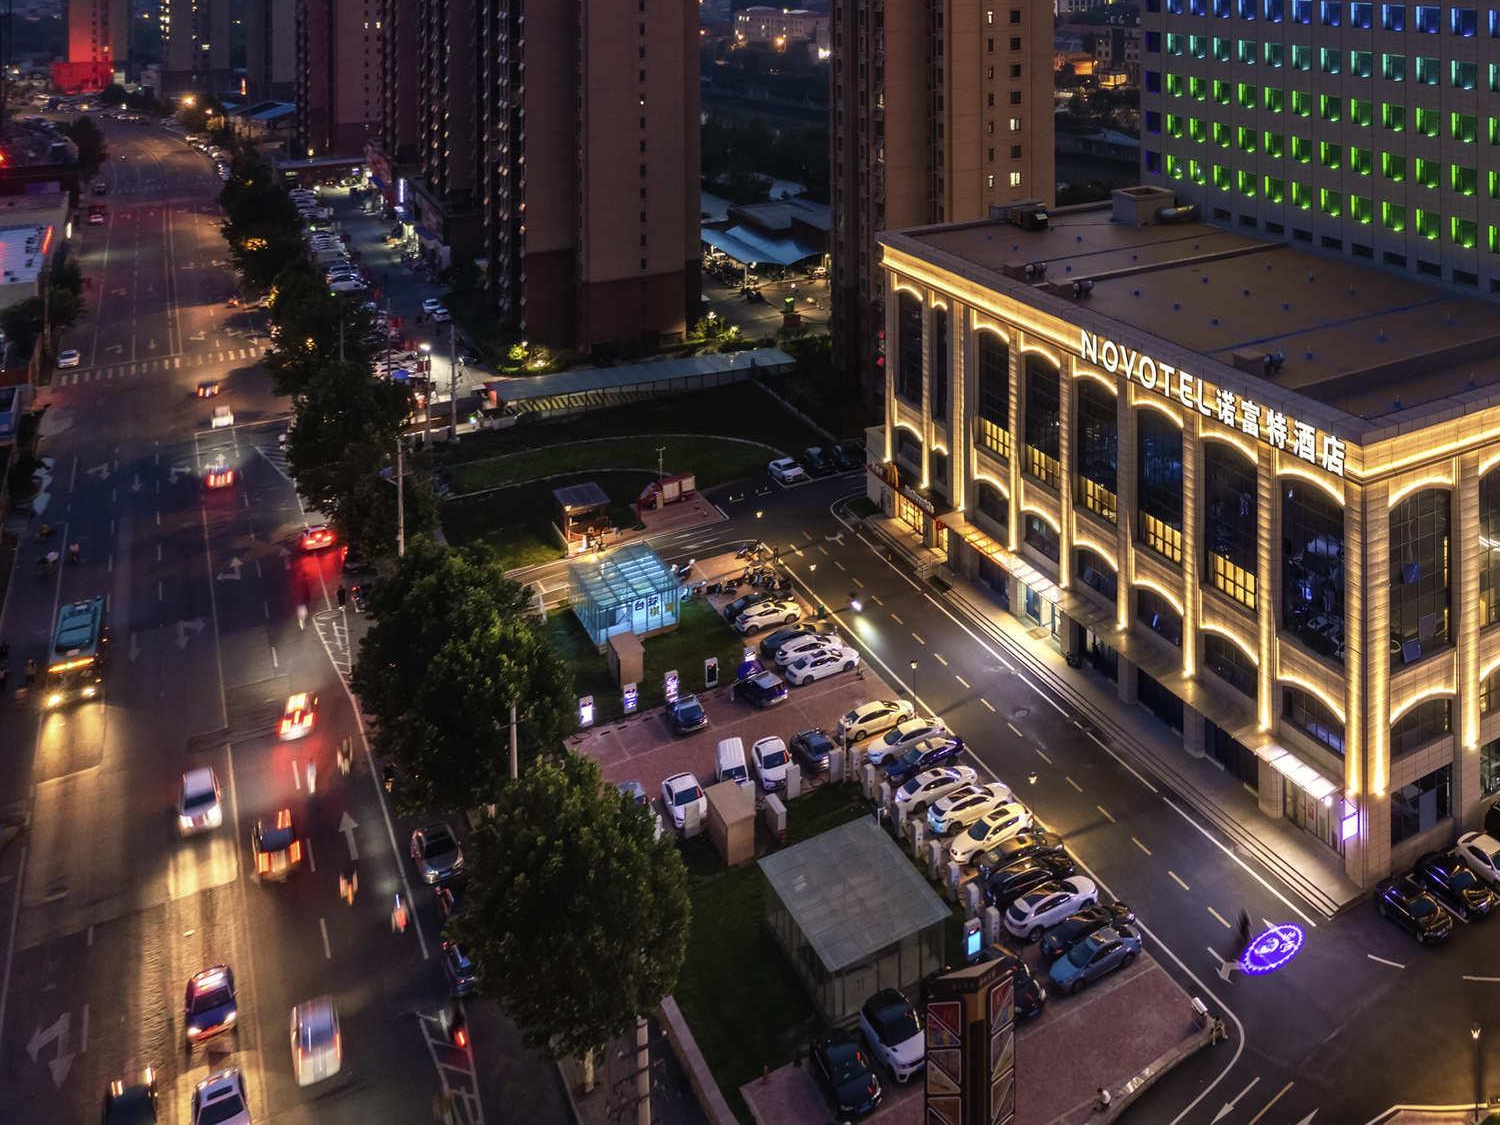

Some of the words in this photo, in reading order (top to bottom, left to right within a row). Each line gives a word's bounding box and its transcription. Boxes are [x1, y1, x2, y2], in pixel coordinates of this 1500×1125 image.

[1080, 329, 1212, 417] NOVOTEL
[1216, 387, 1346, 477] 诺富特酒店
